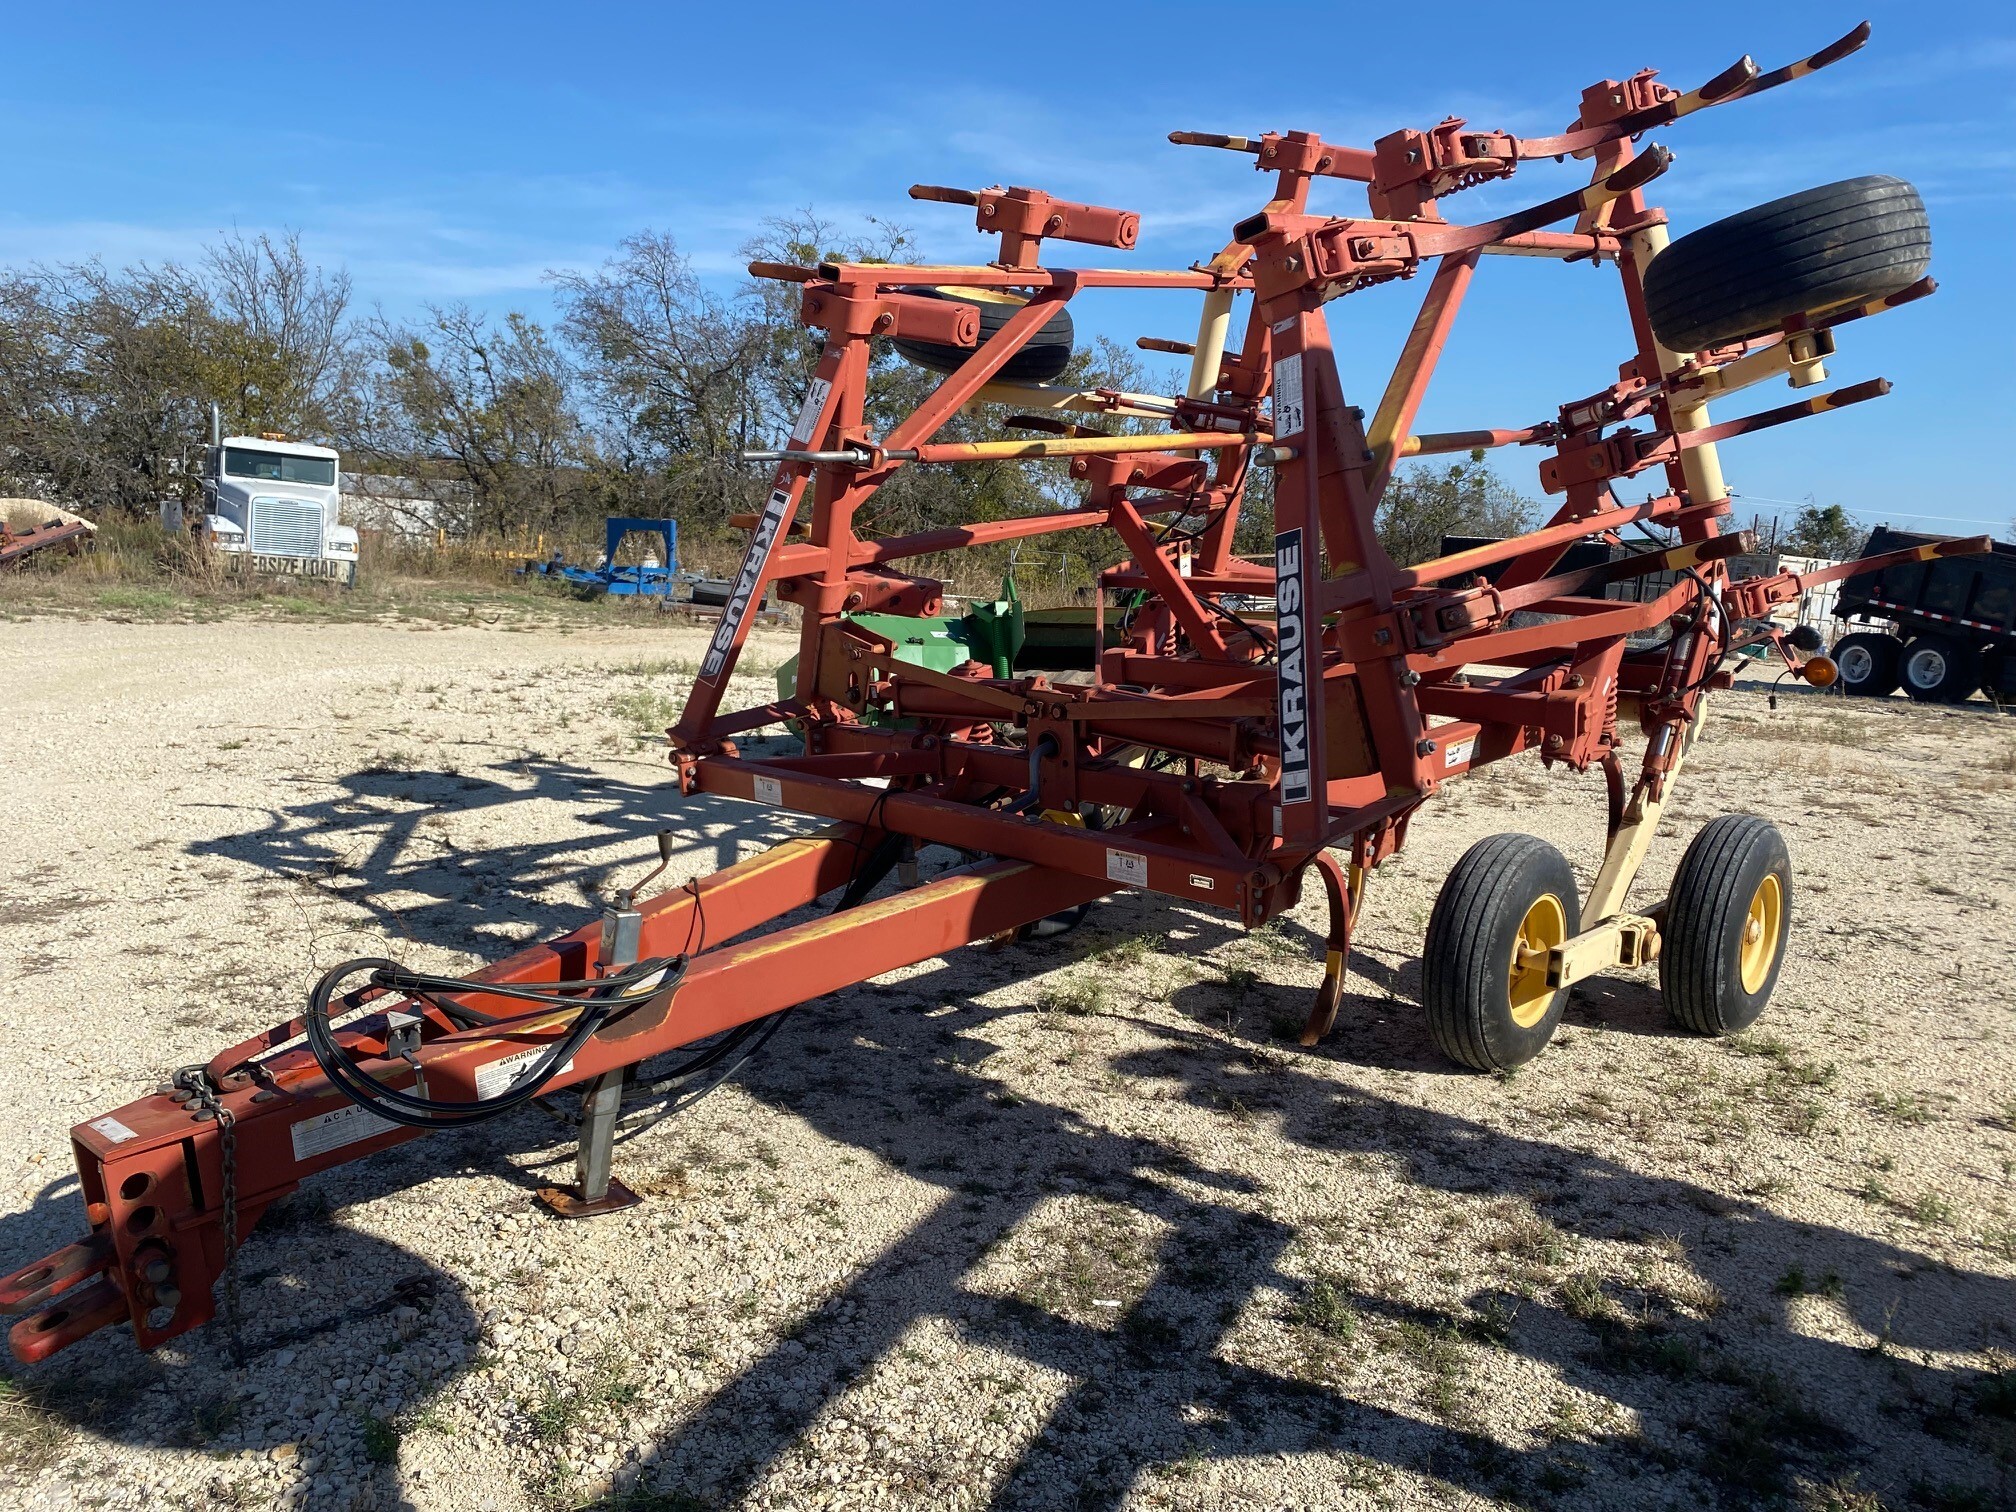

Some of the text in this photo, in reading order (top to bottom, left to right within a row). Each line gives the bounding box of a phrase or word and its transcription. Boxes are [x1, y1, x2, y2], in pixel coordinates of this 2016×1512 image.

[230, 554, 338, 579] OERSIZE LOAD
[705, 519, 777, 676] KRAUSE
[1278, 546, 1306, 764] KRAUSE
[505, 1045, 549, 1064] WARNING
